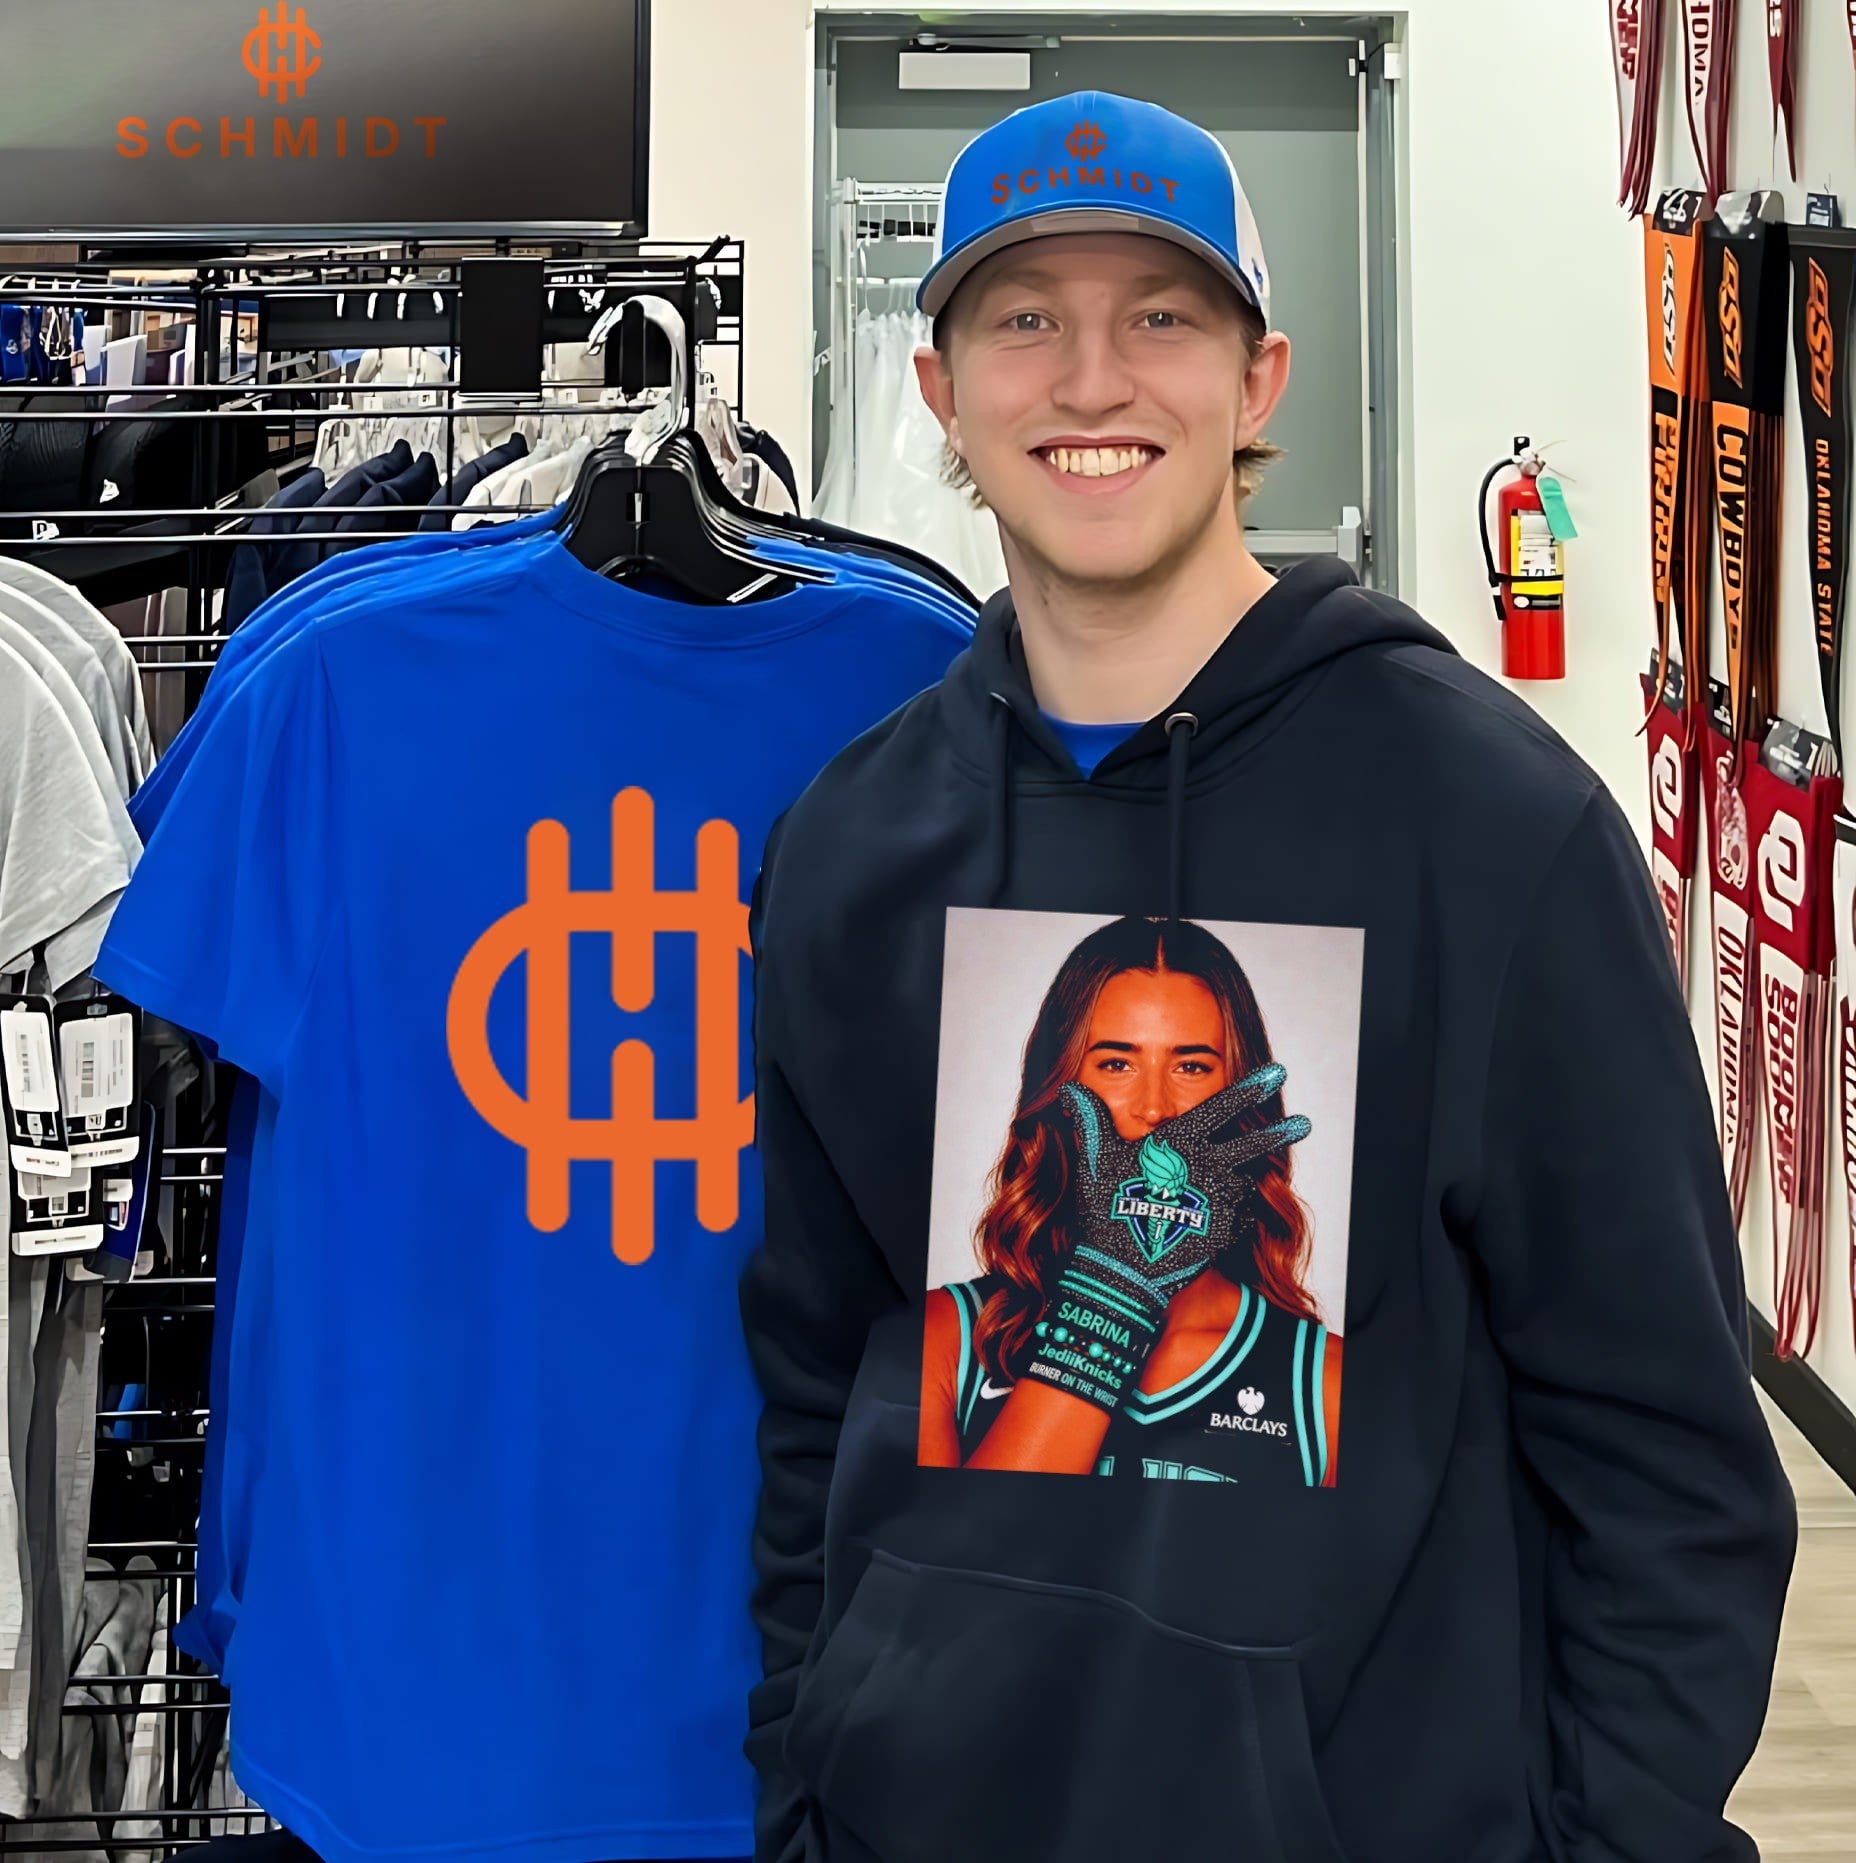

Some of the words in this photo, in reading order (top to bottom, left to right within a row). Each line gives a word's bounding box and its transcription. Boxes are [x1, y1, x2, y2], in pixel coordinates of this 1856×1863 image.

[116, 117, 447, 158] SCHMIDT
[991, 167, 1179, 204] SCHMIDT
[1815, 438, 1833, 571] OKLAHOMA
[1817, 582, 1834, 656] STATE
[1718, 925, 1745, 1144] OKLAHOMA
[1117, 1196, 1205, 1229] LIBERTY
[1058, 1301, 1131, 1349] SABRINA
[1029, 1361, 1062, 1381] BURNER
[1060, 1372, 1076, 1388] ON
[1075, 1379, 1093, 1396] THE
[1093, 1387, 1119, 1408] WRIST
[1038, 1343, 1122, 1390] JediiKnicks
[1209, 1412, 1289, 1438] BARCLAYS
